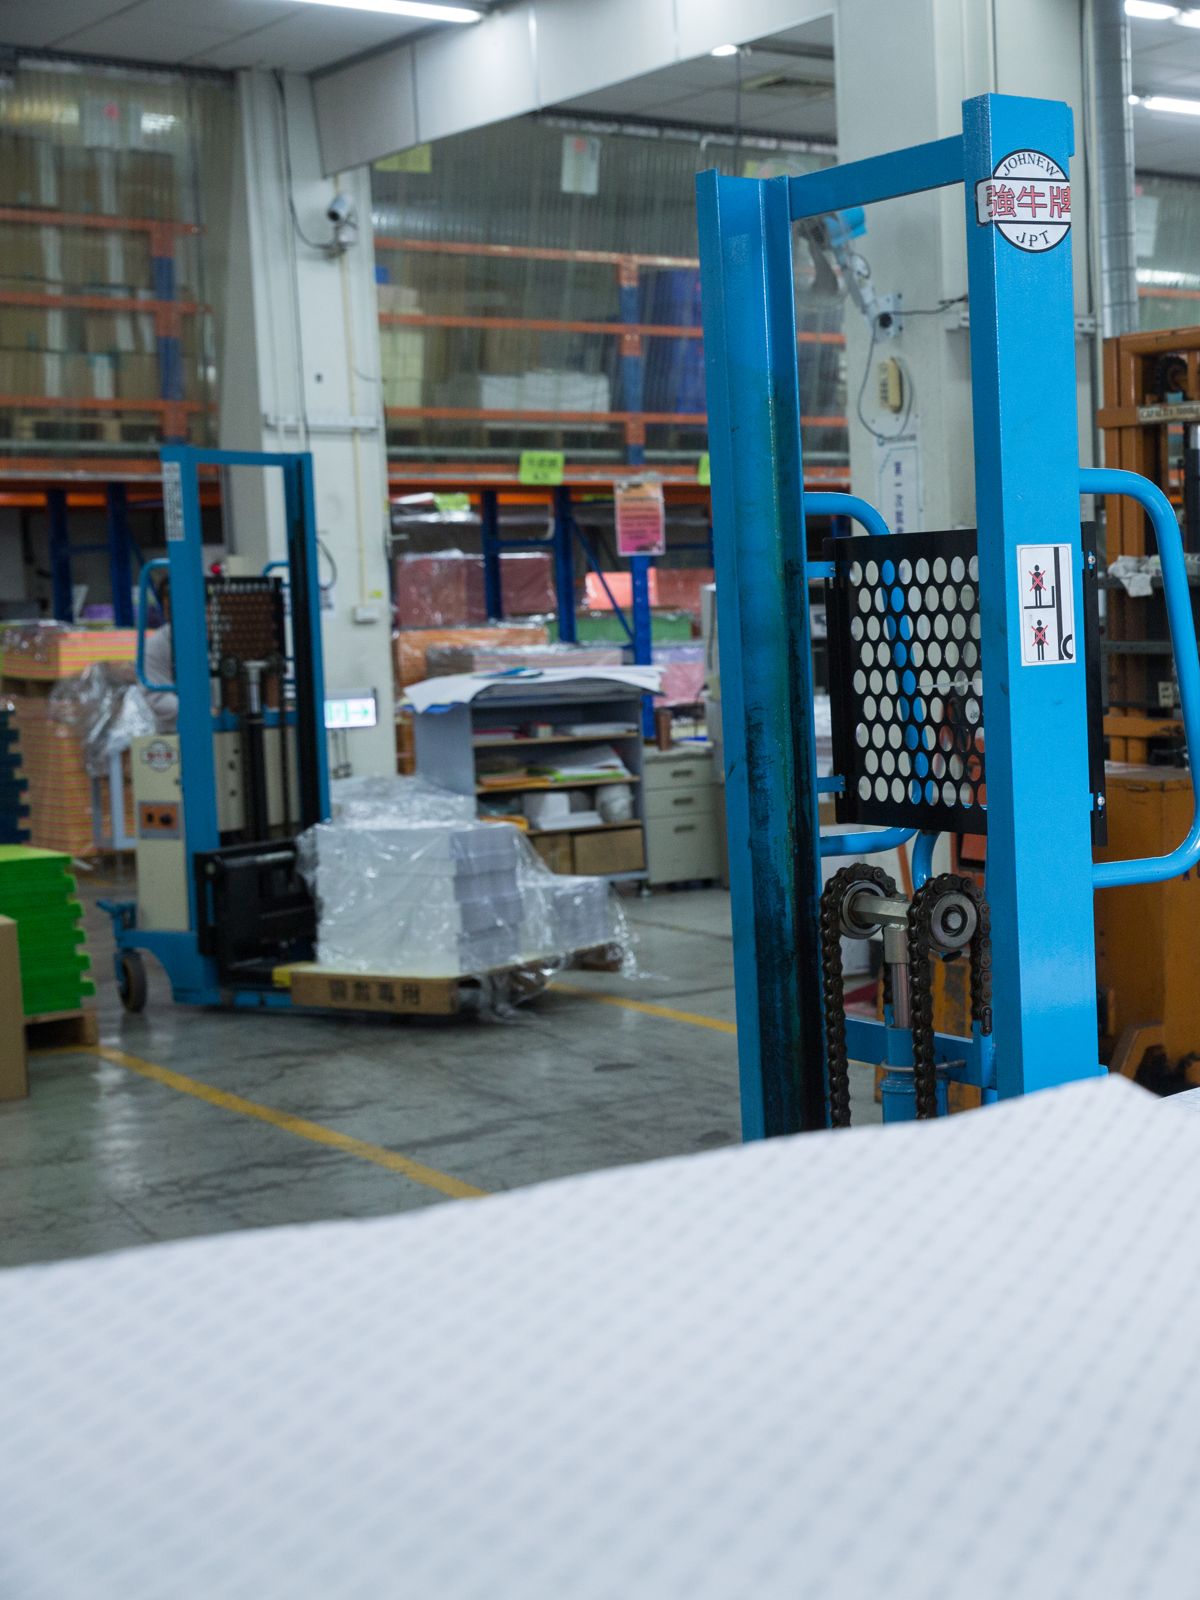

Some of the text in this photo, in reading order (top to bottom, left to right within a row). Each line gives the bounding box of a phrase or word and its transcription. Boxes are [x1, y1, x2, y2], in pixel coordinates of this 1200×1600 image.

[1004, 153, 1060, 177] JOHNEW
[986, 184, 1071, 218] 強牛牌
[1016, 230, 1050, 247] JPT
